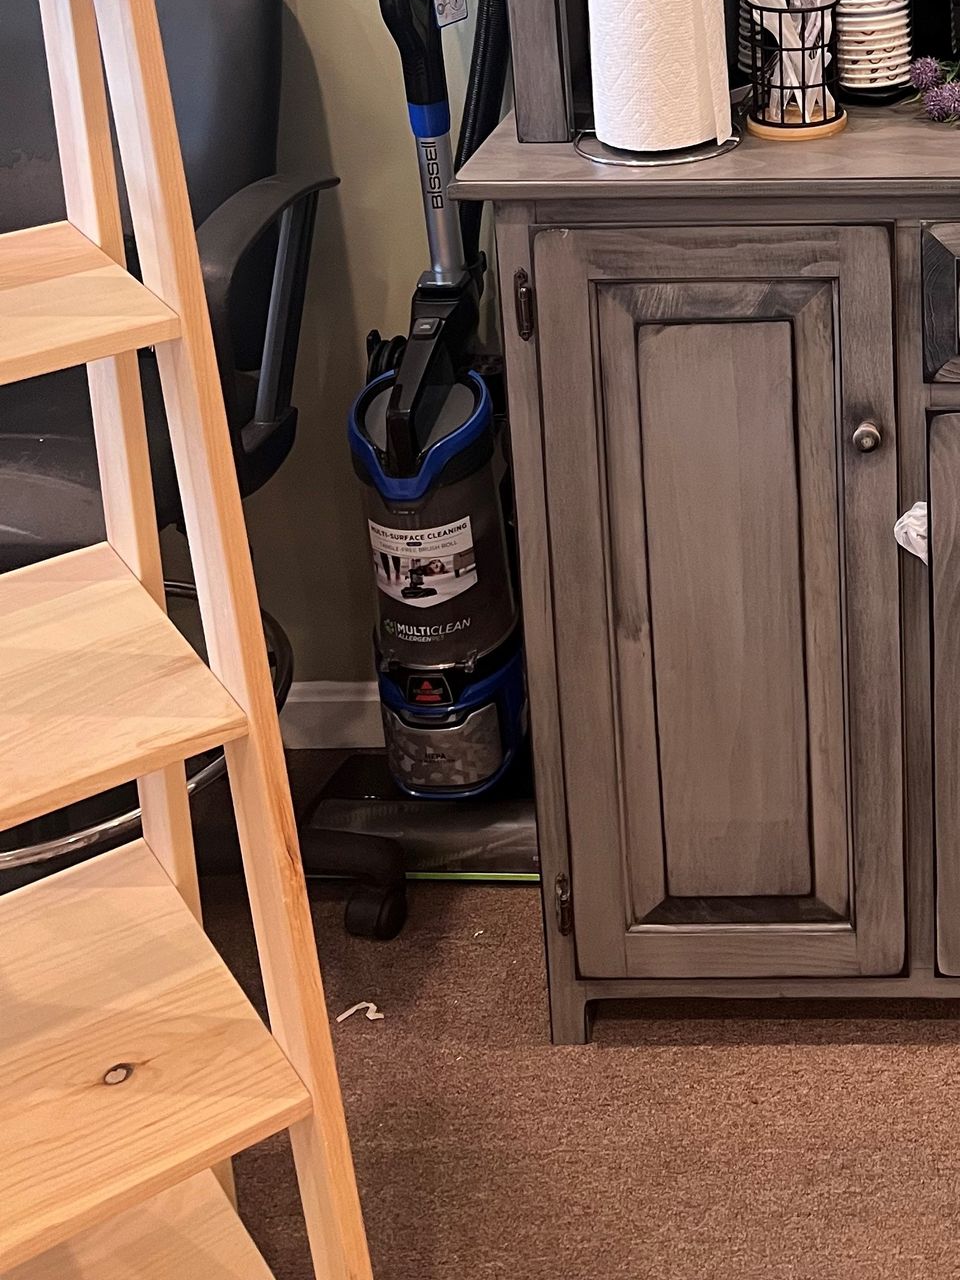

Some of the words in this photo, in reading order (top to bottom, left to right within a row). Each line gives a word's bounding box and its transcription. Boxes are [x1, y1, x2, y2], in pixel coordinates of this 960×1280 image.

[370, 525, 425, 541] MULTI-SURFACE
[427, 522, 468, 539] CLEANING
[397, 617, 471, 636] MULTICLEAN
